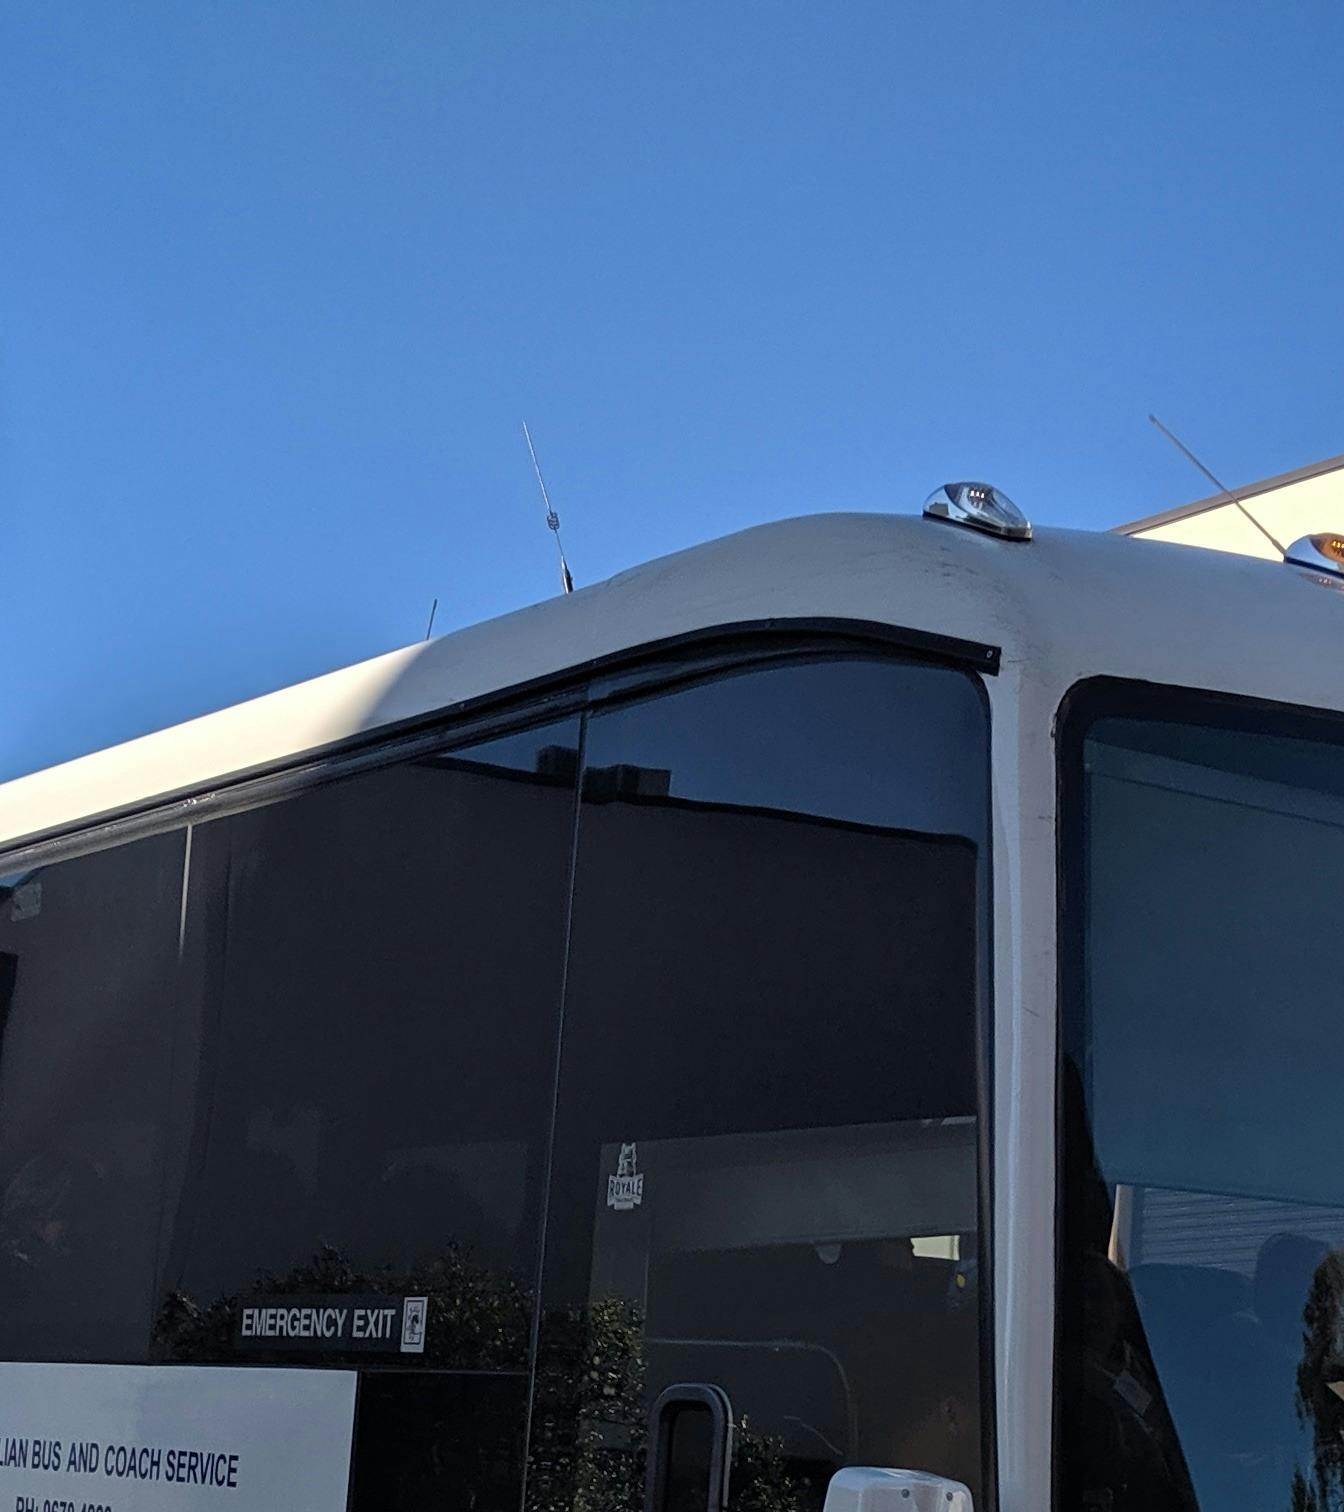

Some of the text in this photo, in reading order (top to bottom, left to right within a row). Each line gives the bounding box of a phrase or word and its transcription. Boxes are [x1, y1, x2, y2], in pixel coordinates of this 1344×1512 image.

[609, 1178, 642, 1196] ROYALE
[241, 1308, 396, 1338] EMERGENCY EXIT
[31, 1439, 62, 1472] BUS
[66, 1441, 100, 1473] AND
[105, 1445, 161, 1481] COACH
[165, 1449, 240, 1488] SERVICE
